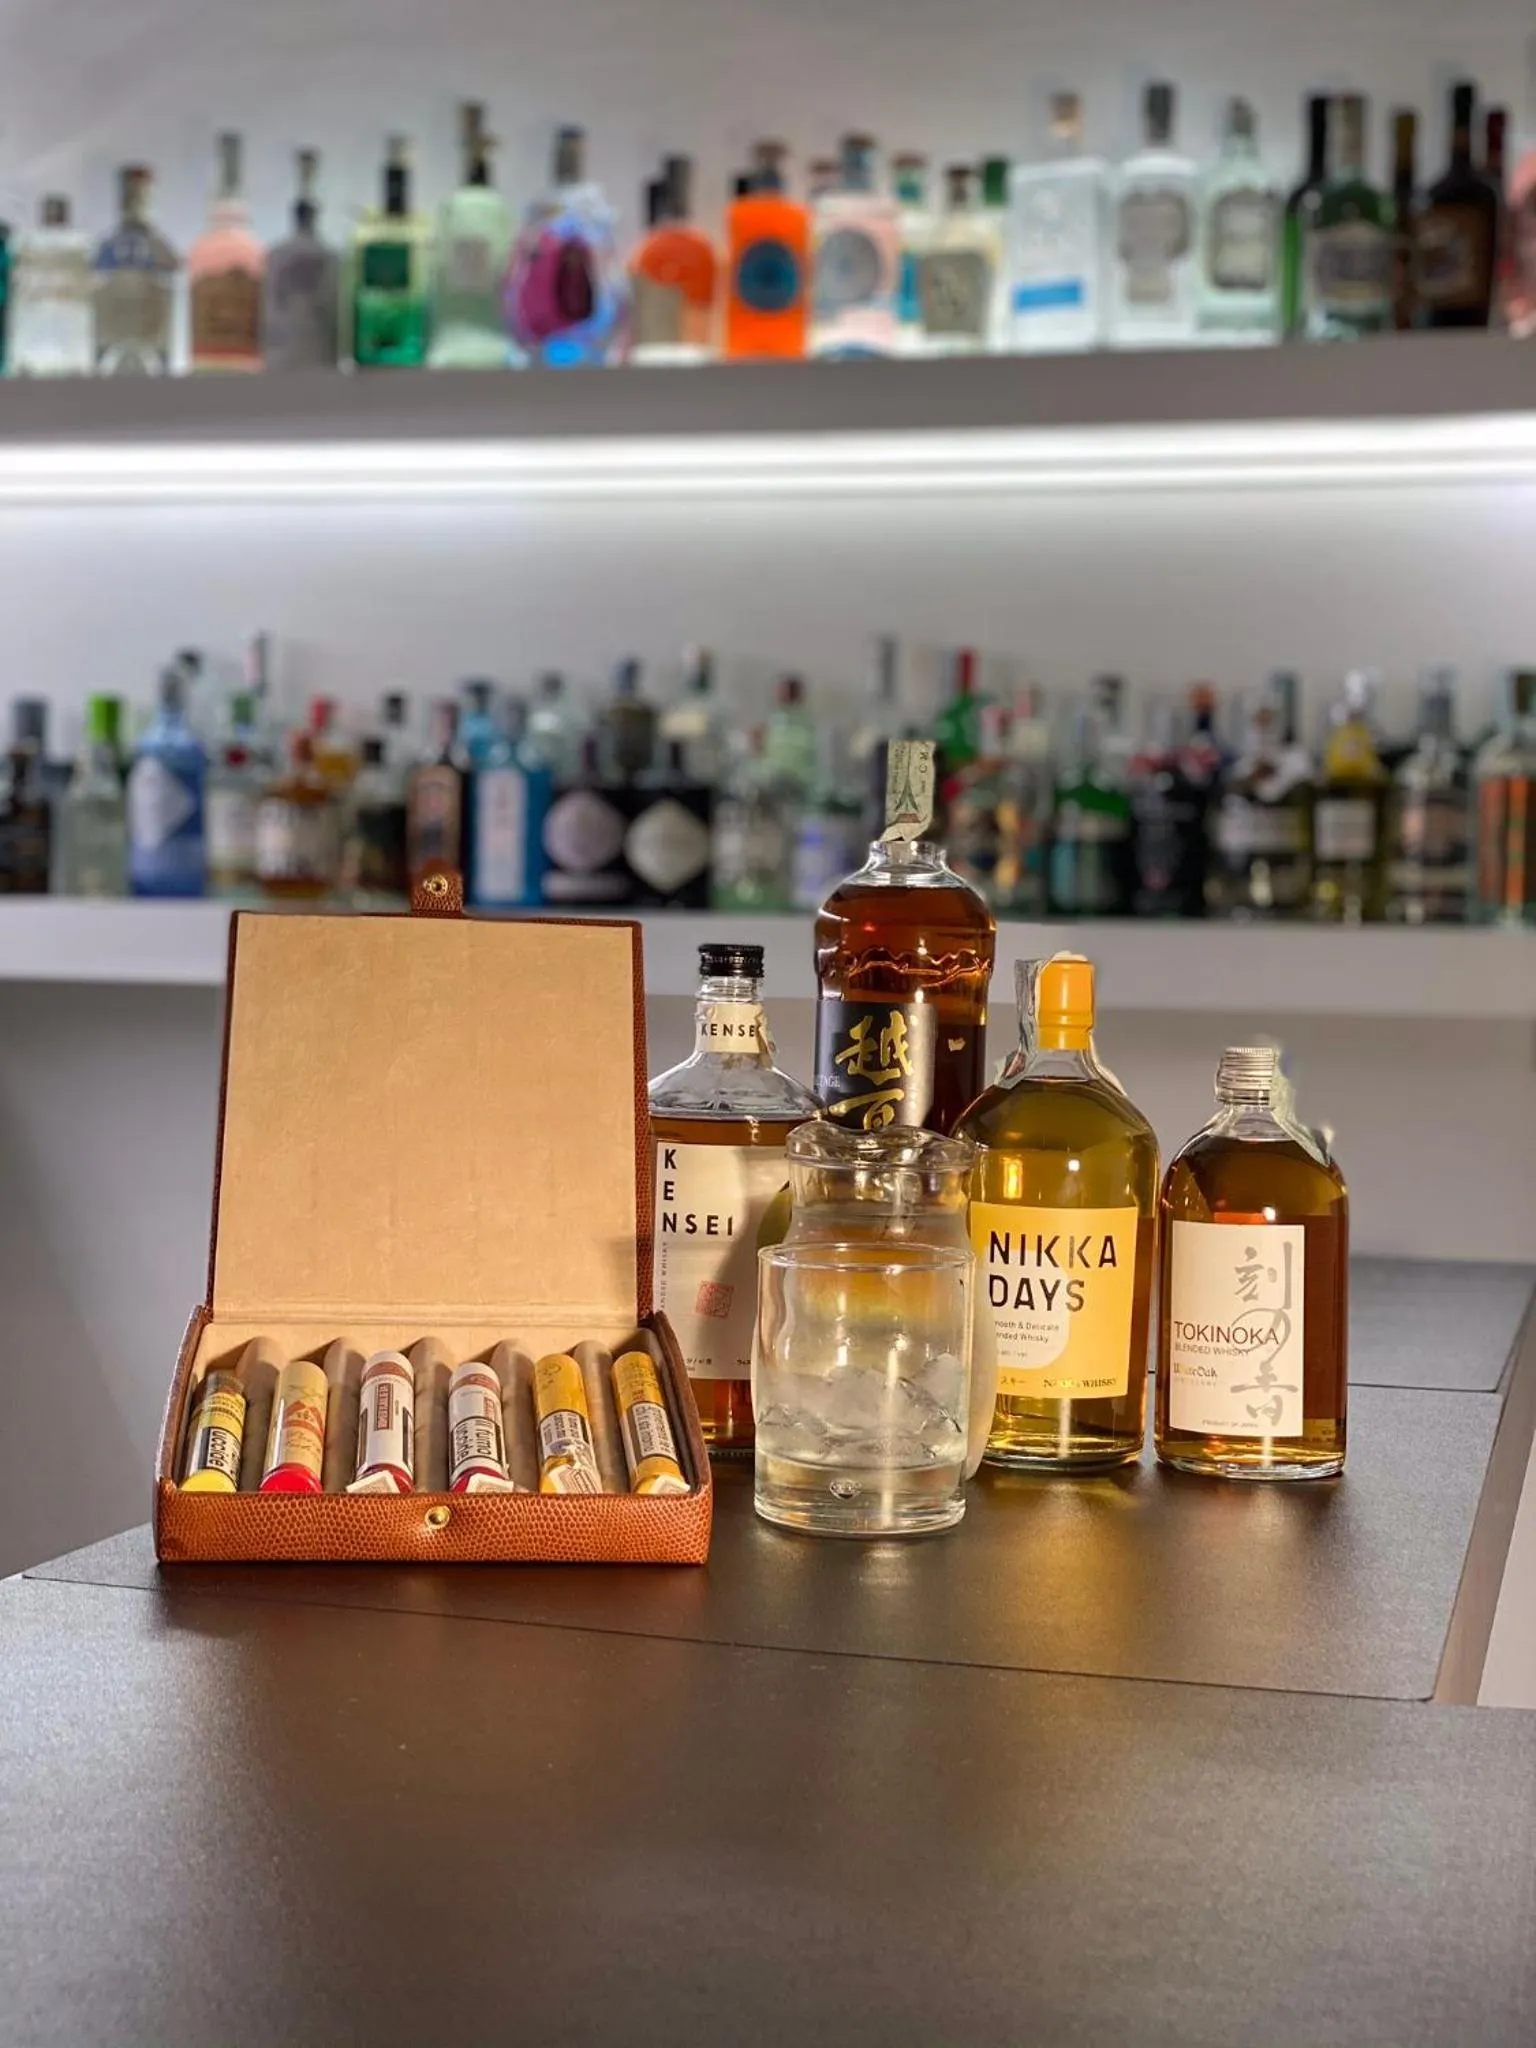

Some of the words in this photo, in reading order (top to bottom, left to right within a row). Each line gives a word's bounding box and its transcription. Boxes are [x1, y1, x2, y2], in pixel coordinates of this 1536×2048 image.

[989, 1230, 1118, 1269] NIKKA
[988, 1274, 1086, 1313] DAYS
[996, 1332, 1018, 1340] ended
[1019, 1333, 1049, 1344] Whisky
[1173, 1320, 1280, 1346] TOKINOKA
[1175, 1343, 1211, 1355] BLENDED
[1213, 1345, 1250, 1358] WHISKY
[209, 1430, 230, 1468] uccide
